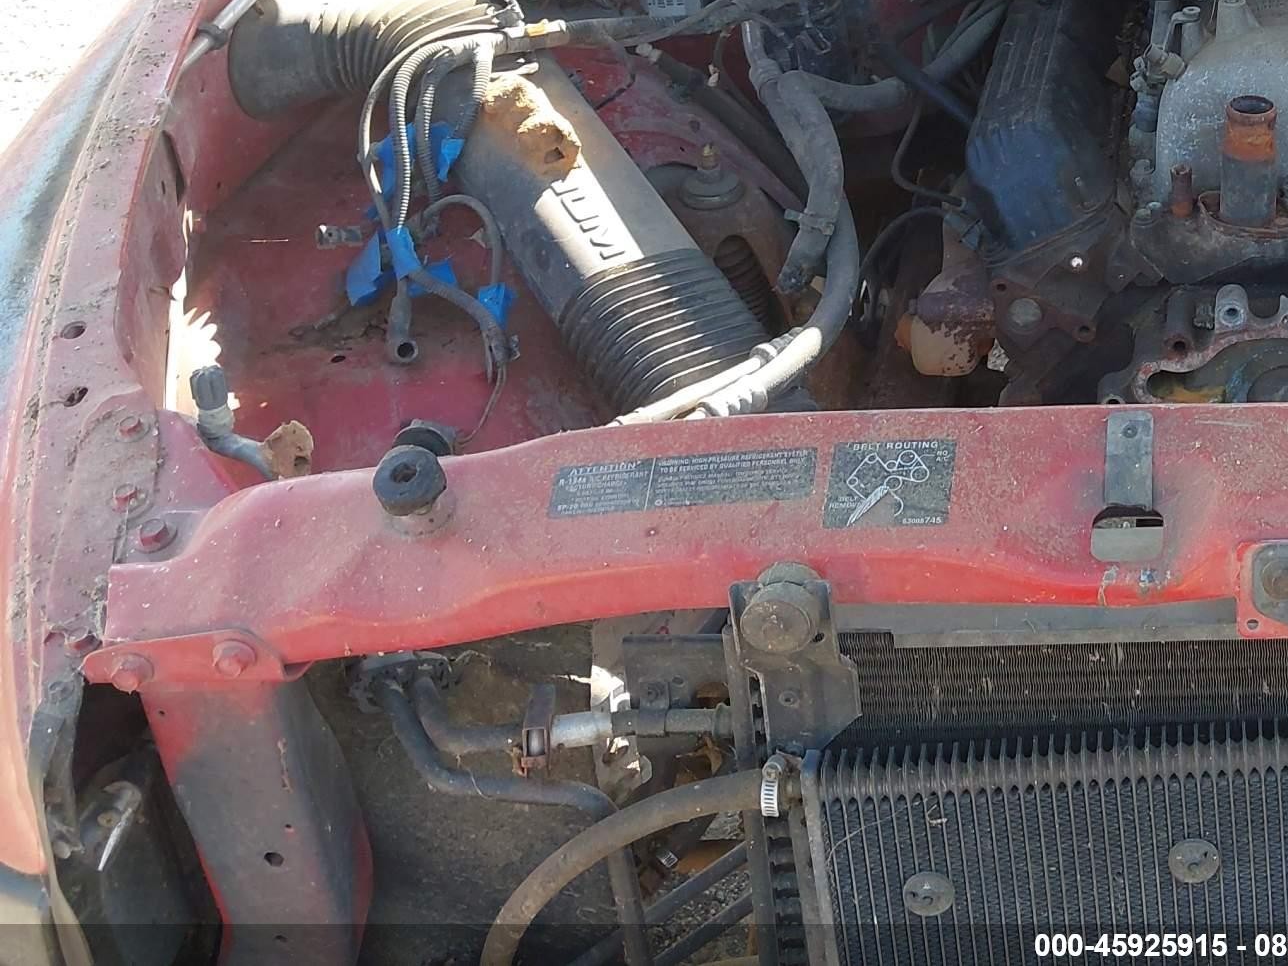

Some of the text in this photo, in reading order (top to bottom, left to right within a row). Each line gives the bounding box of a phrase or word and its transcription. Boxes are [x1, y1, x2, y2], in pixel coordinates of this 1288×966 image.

[886, 441, 938, 449] ROUTING
[678, 464, 708, 472] SERVICED
[720, 461, 750, 469] QUALIFIED
[752, 459, 788, 467] PERSONNEL
